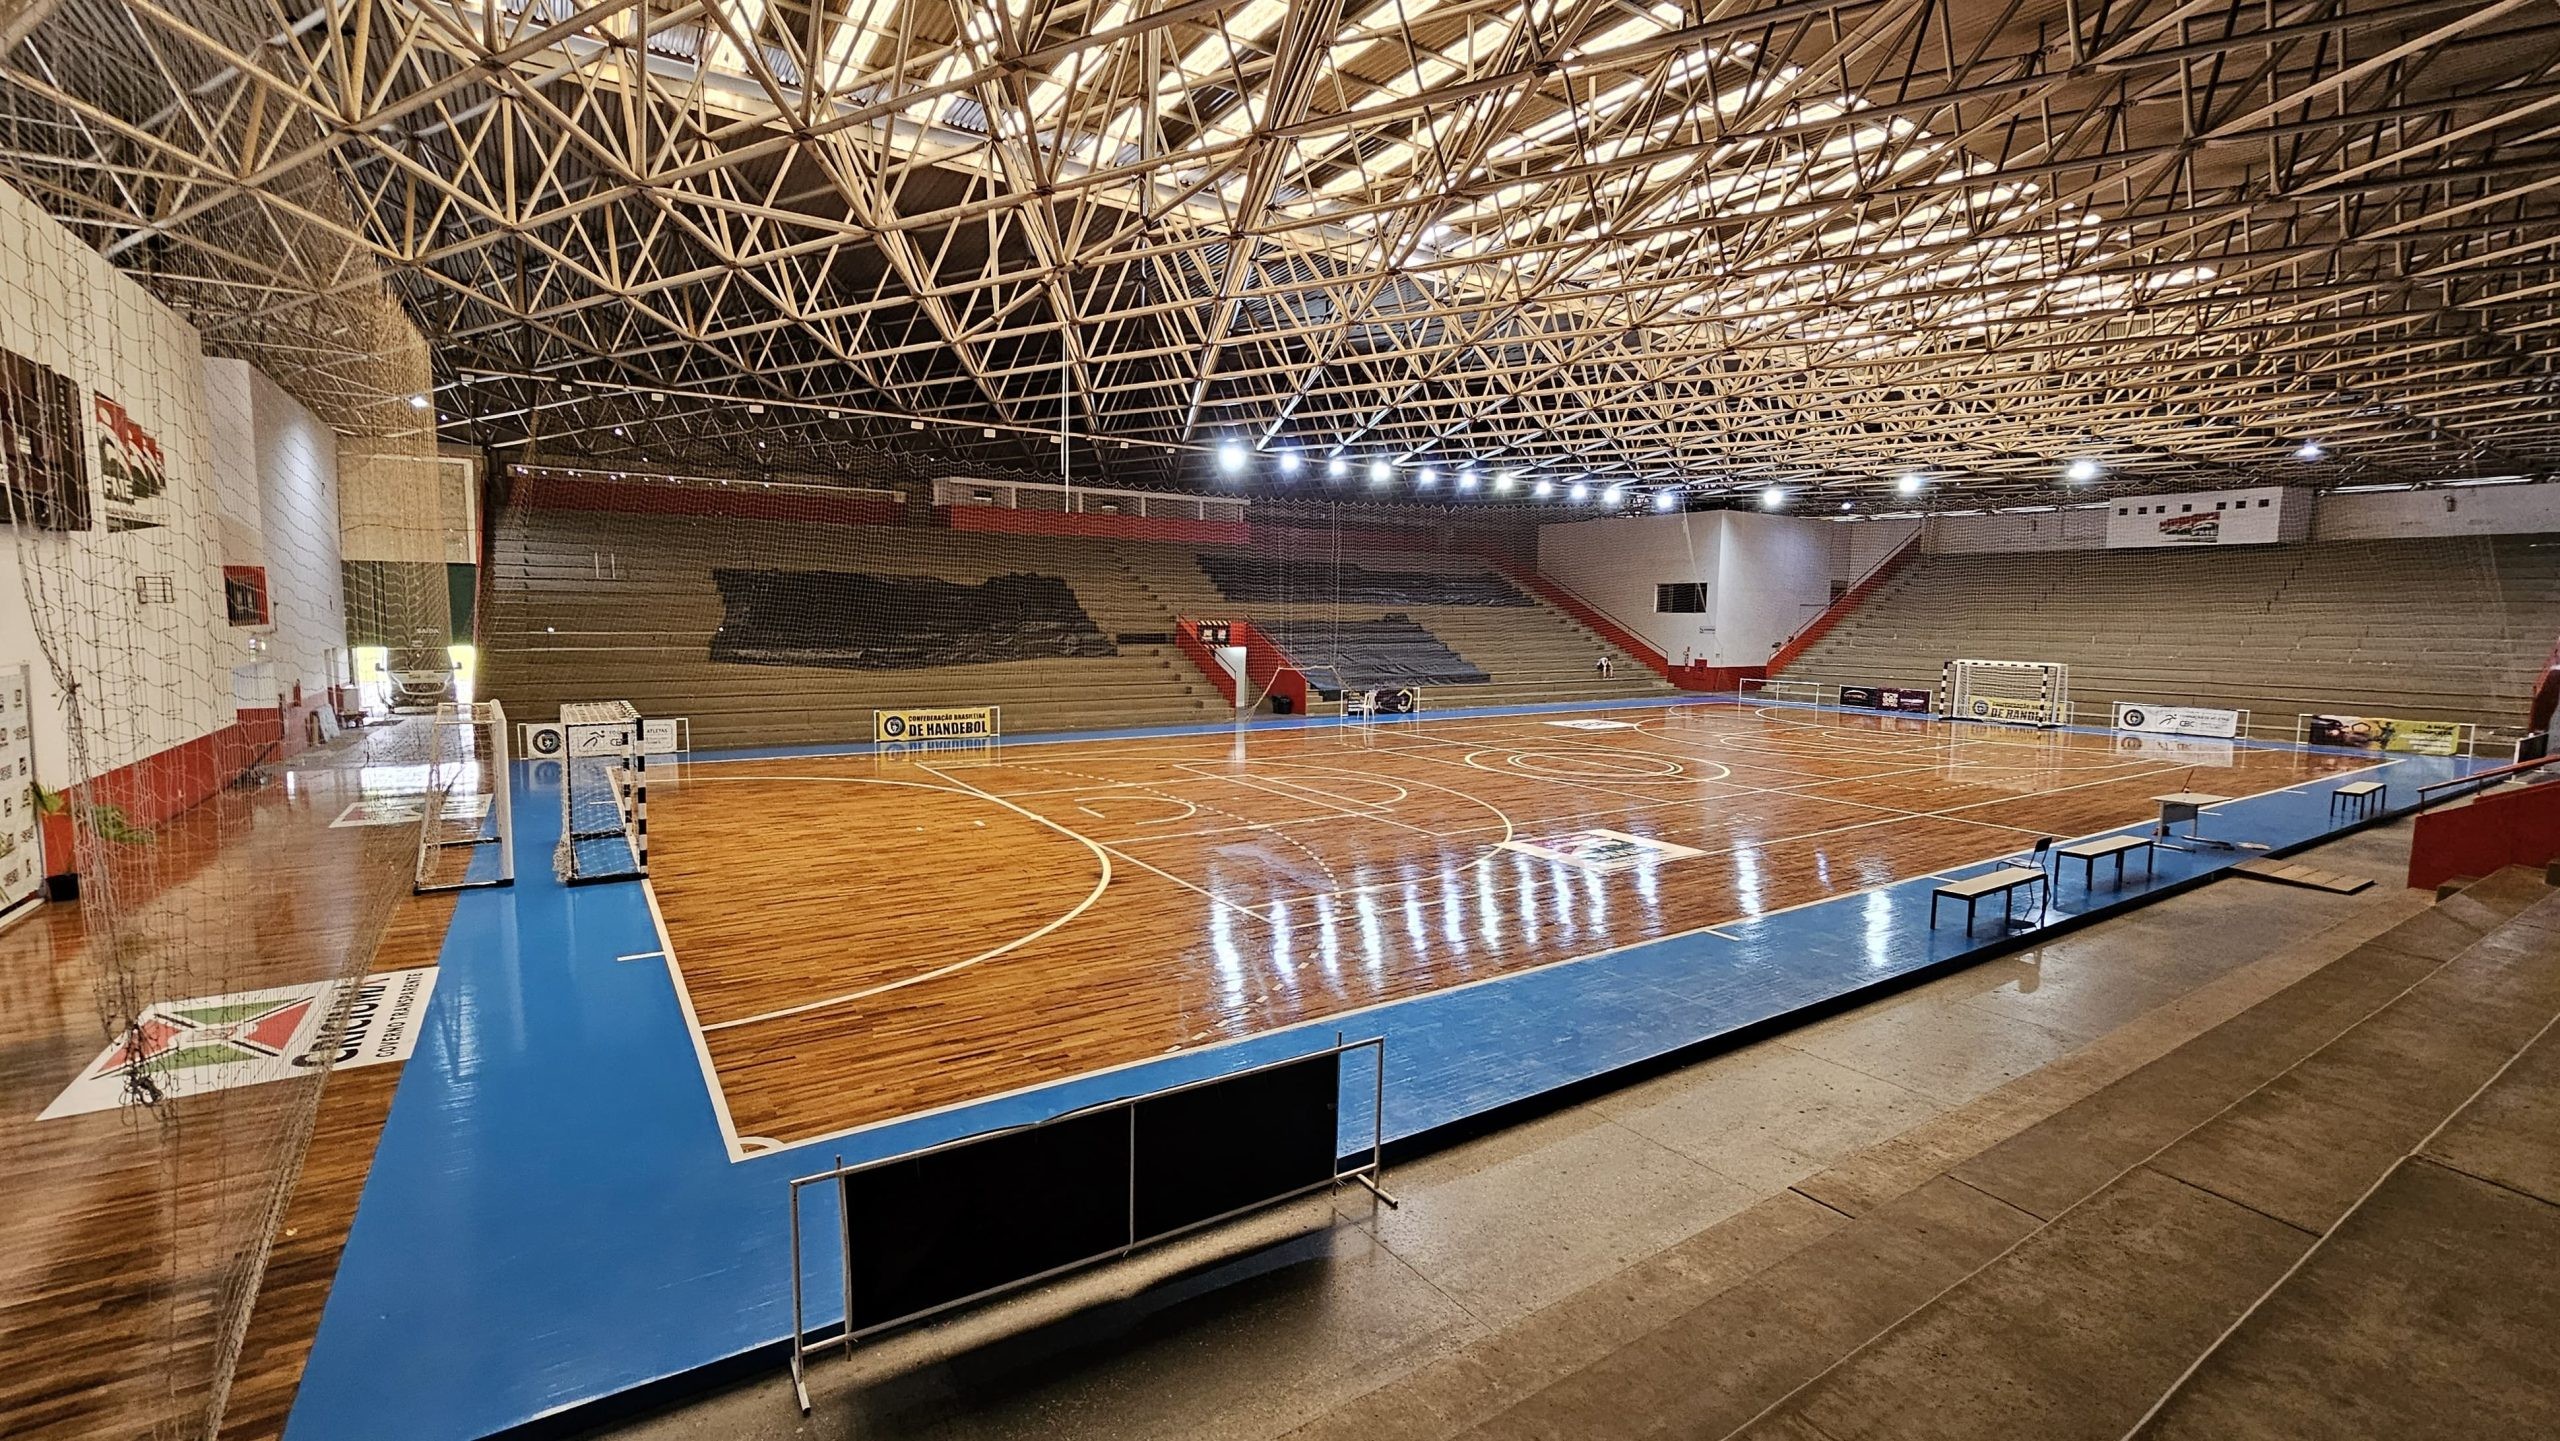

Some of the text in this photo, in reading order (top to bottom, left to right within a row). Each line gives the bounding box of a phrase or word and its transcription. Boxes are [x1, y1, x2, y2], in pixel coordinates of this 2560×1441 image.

[102, 474, 134, 500] FME
[908, 714, 953, 722] CONFEDERAÇÃO
[908, 720, 988, 737] DE HANDEBOL
[375, 972, 423, 1058] GOVERNO TRANSPARENTE
